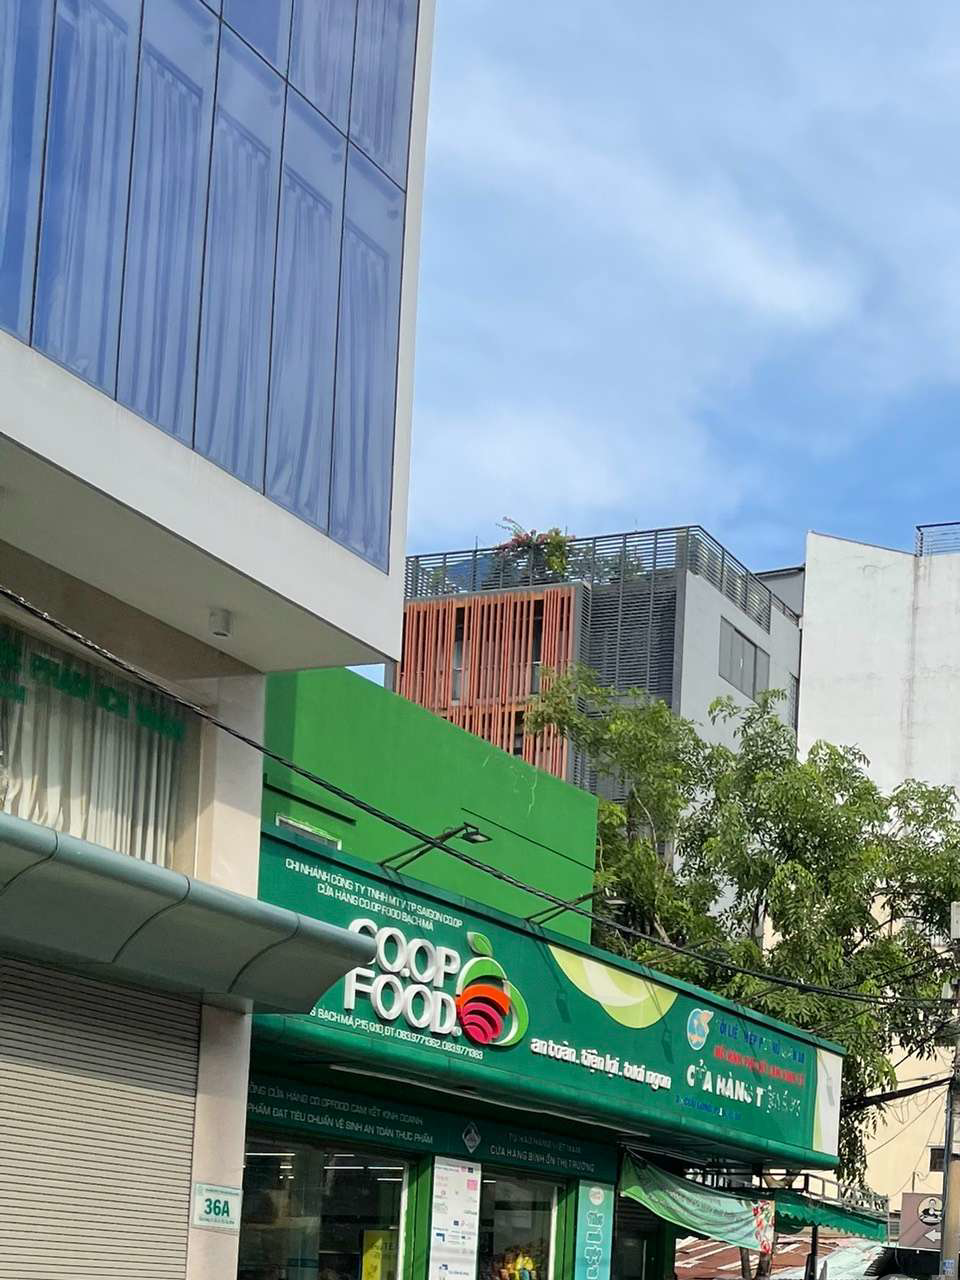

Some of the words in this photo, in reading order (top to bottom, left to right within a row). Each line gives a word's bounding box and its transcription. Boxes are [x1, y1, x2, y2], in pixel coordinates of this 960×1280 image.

[285, 858, 299, 872] CHI
[300, 863, 330, 882] NHÁNH
[331, 873, 353, 890] CÔNG
[354, 882, 366, 894] TY
[366, 886, 388, 903] TNHH
[417, 904, 442, 922] SAIGON
[317, 883, 334, 898] CỬA
[335, 888, 358, 906] HÀNG
[381, 905, 400, 920] FOOD
[401, 911, 421, 926] BẠCH
[343, 966, 458, 1035] FOOD
[530, 1038, 548, 1055] an
[645, 1070, 672, 1090] ngon
[289, 1109, 306, 1122] TIÊU
[345, 1120, 363, 1132] SINH
[363, 1123, 375, 1135] AN
[375, 1126, 394, 1138] TOÀN
[204, 1197, 230, 1217] 36A
